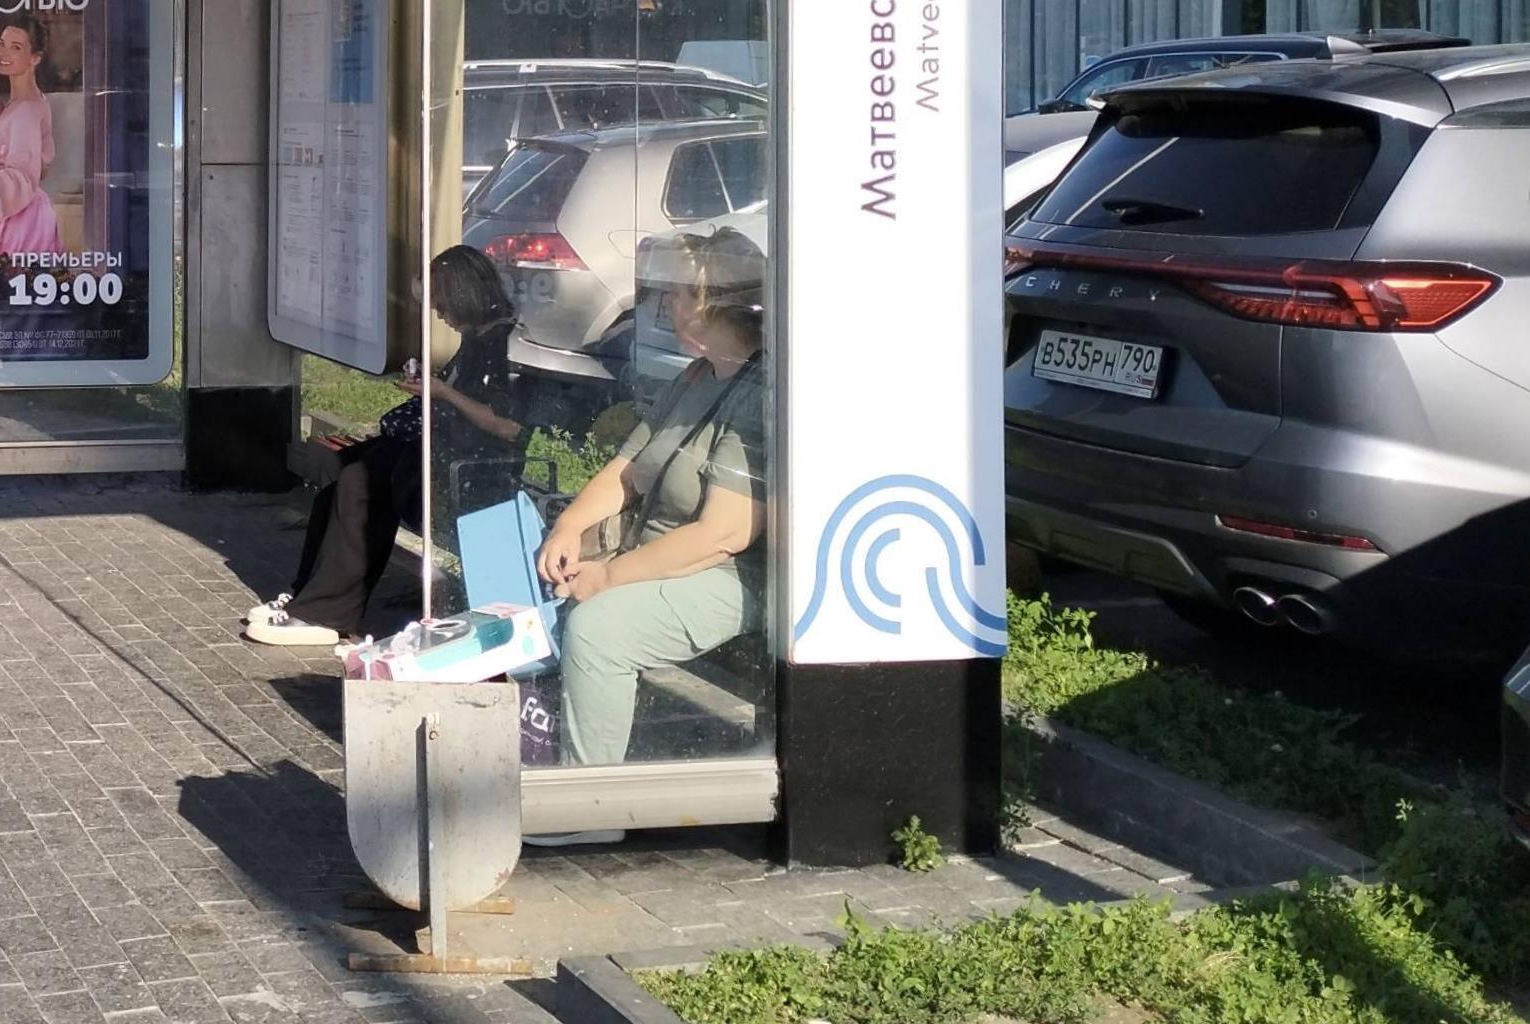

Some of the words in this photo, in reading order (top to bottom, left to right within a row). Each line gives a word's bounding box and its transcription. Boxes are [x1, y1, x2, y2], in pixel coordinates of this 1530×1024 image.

[12, 251, 122, 268] ПРЕМЬЕРЫ
[9, 273, 123, 305] 19:00
[1025, 276, 1160, 301] CHERY
[1121, 345, 1155, 373] 790
